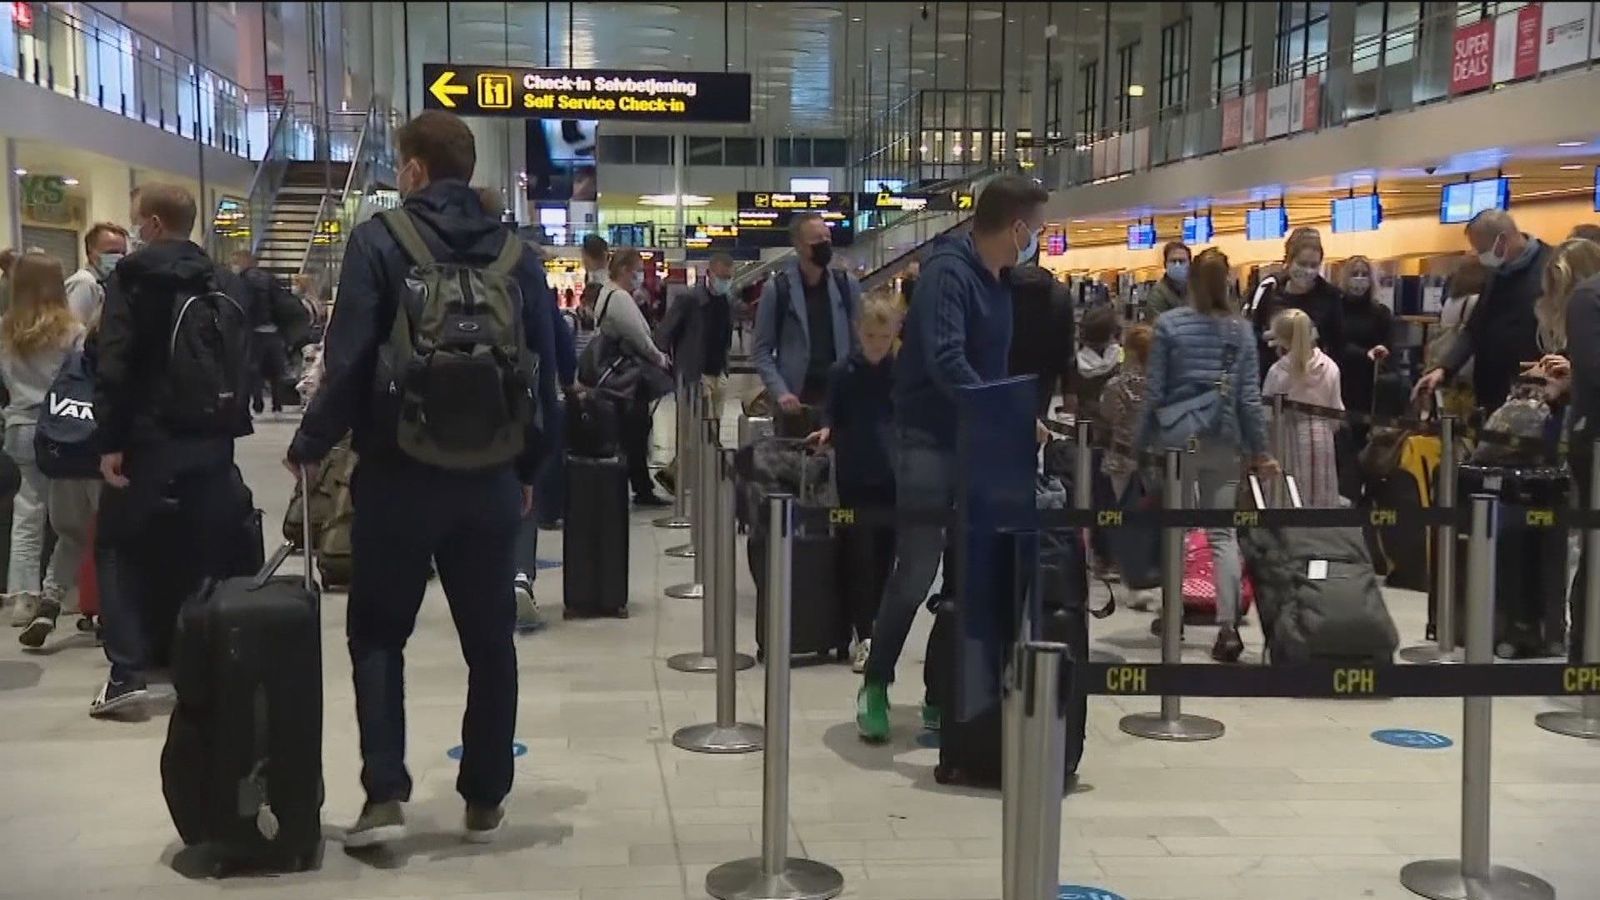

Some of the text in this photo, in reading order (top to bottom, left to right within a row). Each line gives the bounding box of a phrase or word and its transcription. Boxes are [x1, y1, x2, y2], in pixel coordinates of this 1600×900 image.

[1455, 33, 1489, 60] SUPER
[1453, 55, 1488, 82] DEALS
[523, 74, 697, 96] Check-in Selvbetjening
[523, 93, 685, 112] Self Service Check-in
[50, 392, 94, 420] VAN
[829, 509, 854, 523] CPH
[1097, 510, 1555, 526] CPH CPH CPH CPH
[1106, 667, 1600, 692] CPH CPH CPH
